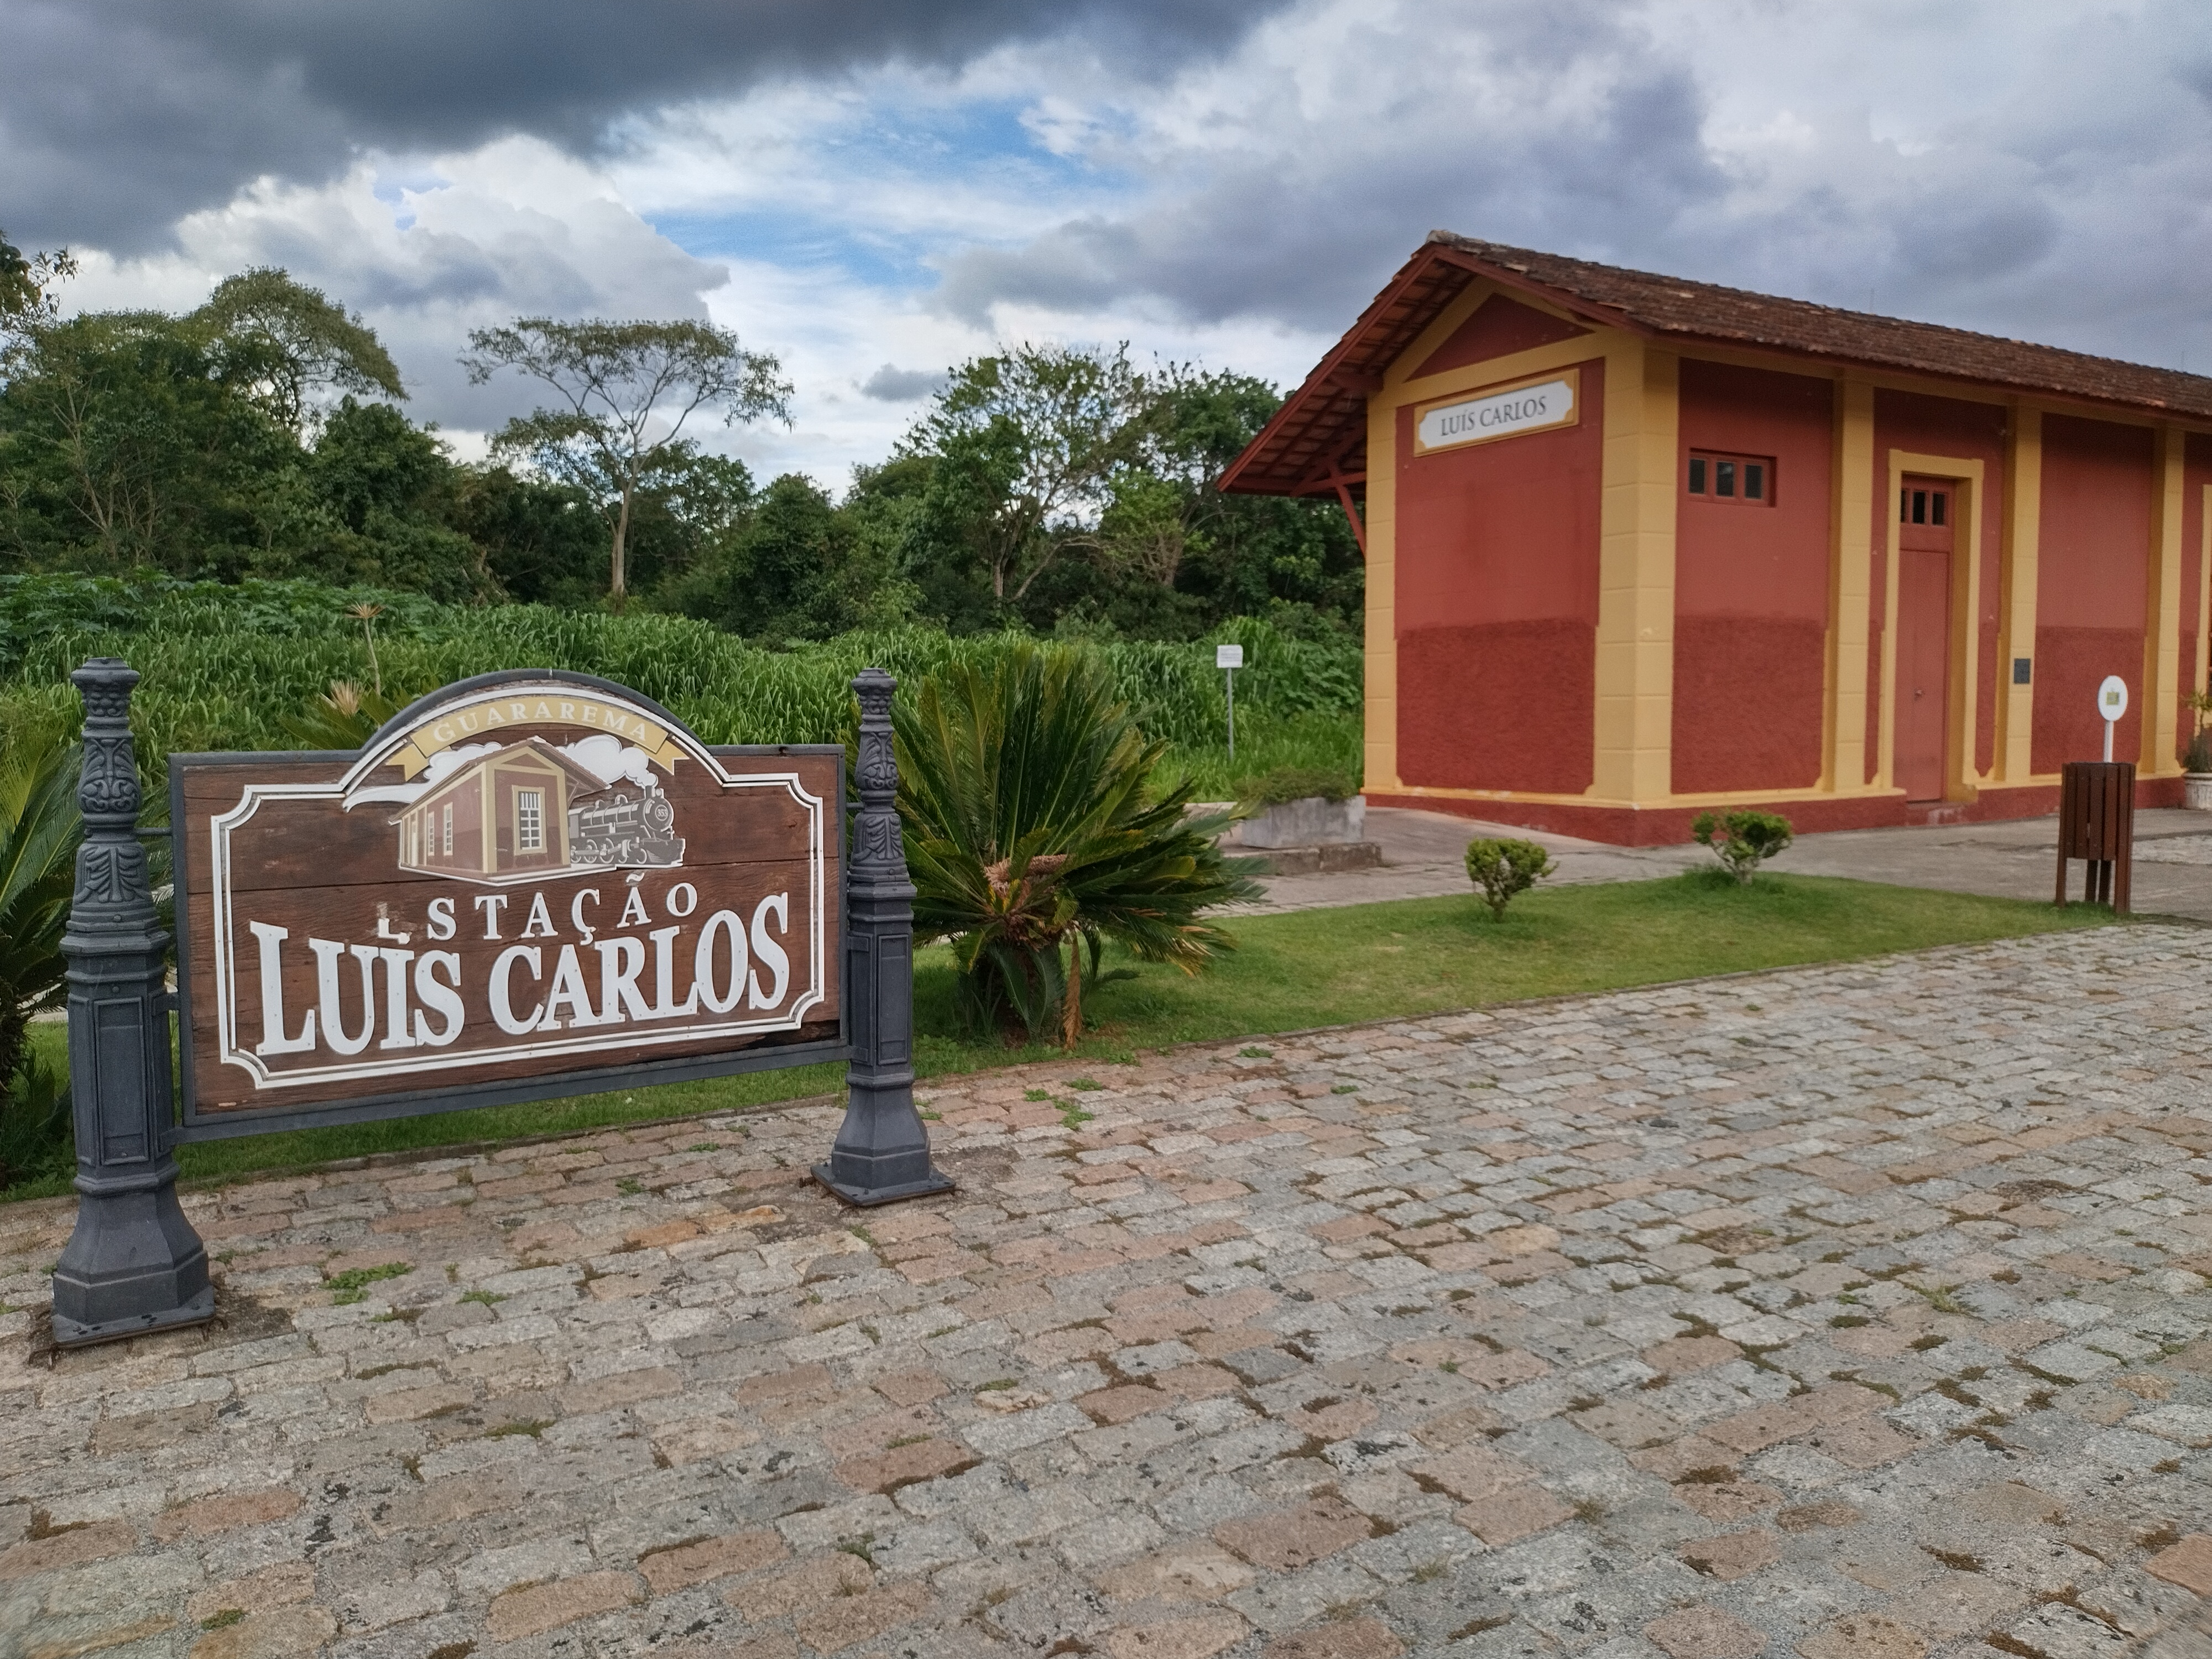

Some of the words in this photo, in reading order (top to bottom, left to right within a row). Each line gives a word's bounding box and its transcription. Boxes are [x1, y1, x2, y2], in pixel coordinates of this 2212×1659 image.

[1441, 409, 1475, 437] LUÍS
[1479, 395, 1547, 427] CARLOS
[433, 701, 646, 743] GUARAREMA
[657, 808, 667, 817] 353
[489, 891, 790, 1035] CARLOS
